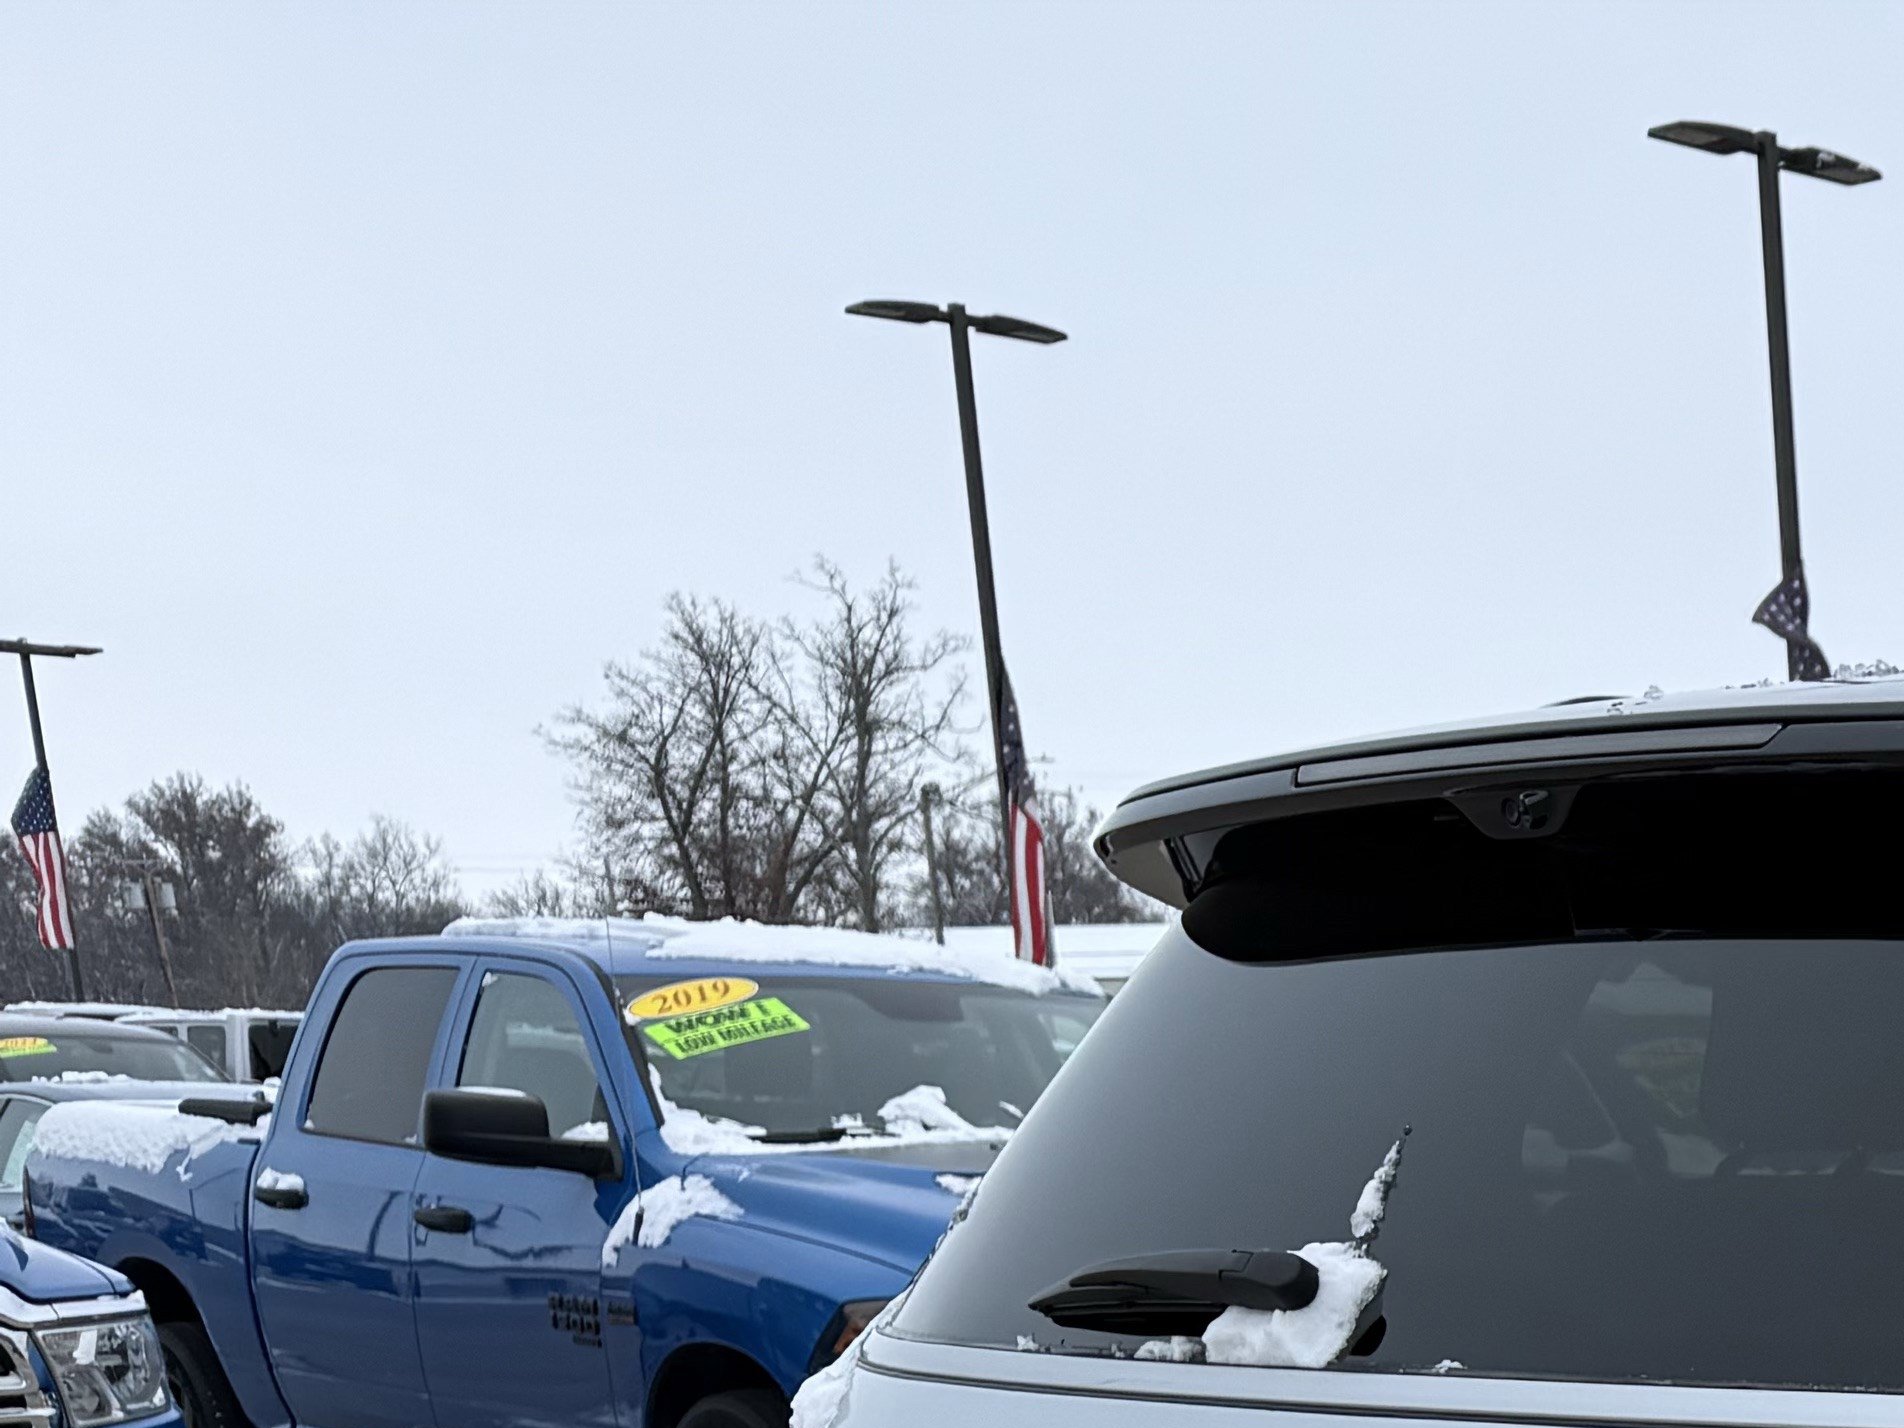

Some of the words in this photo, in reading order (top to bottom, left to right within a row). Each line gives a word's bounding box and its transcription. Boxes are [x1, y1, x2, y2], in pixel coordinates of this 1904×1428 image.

[651, 979, 730, 1014] 2019
[675, 1031, 716, 1053] LOW
[718, 1014, 797, 1041] MILEAGE
